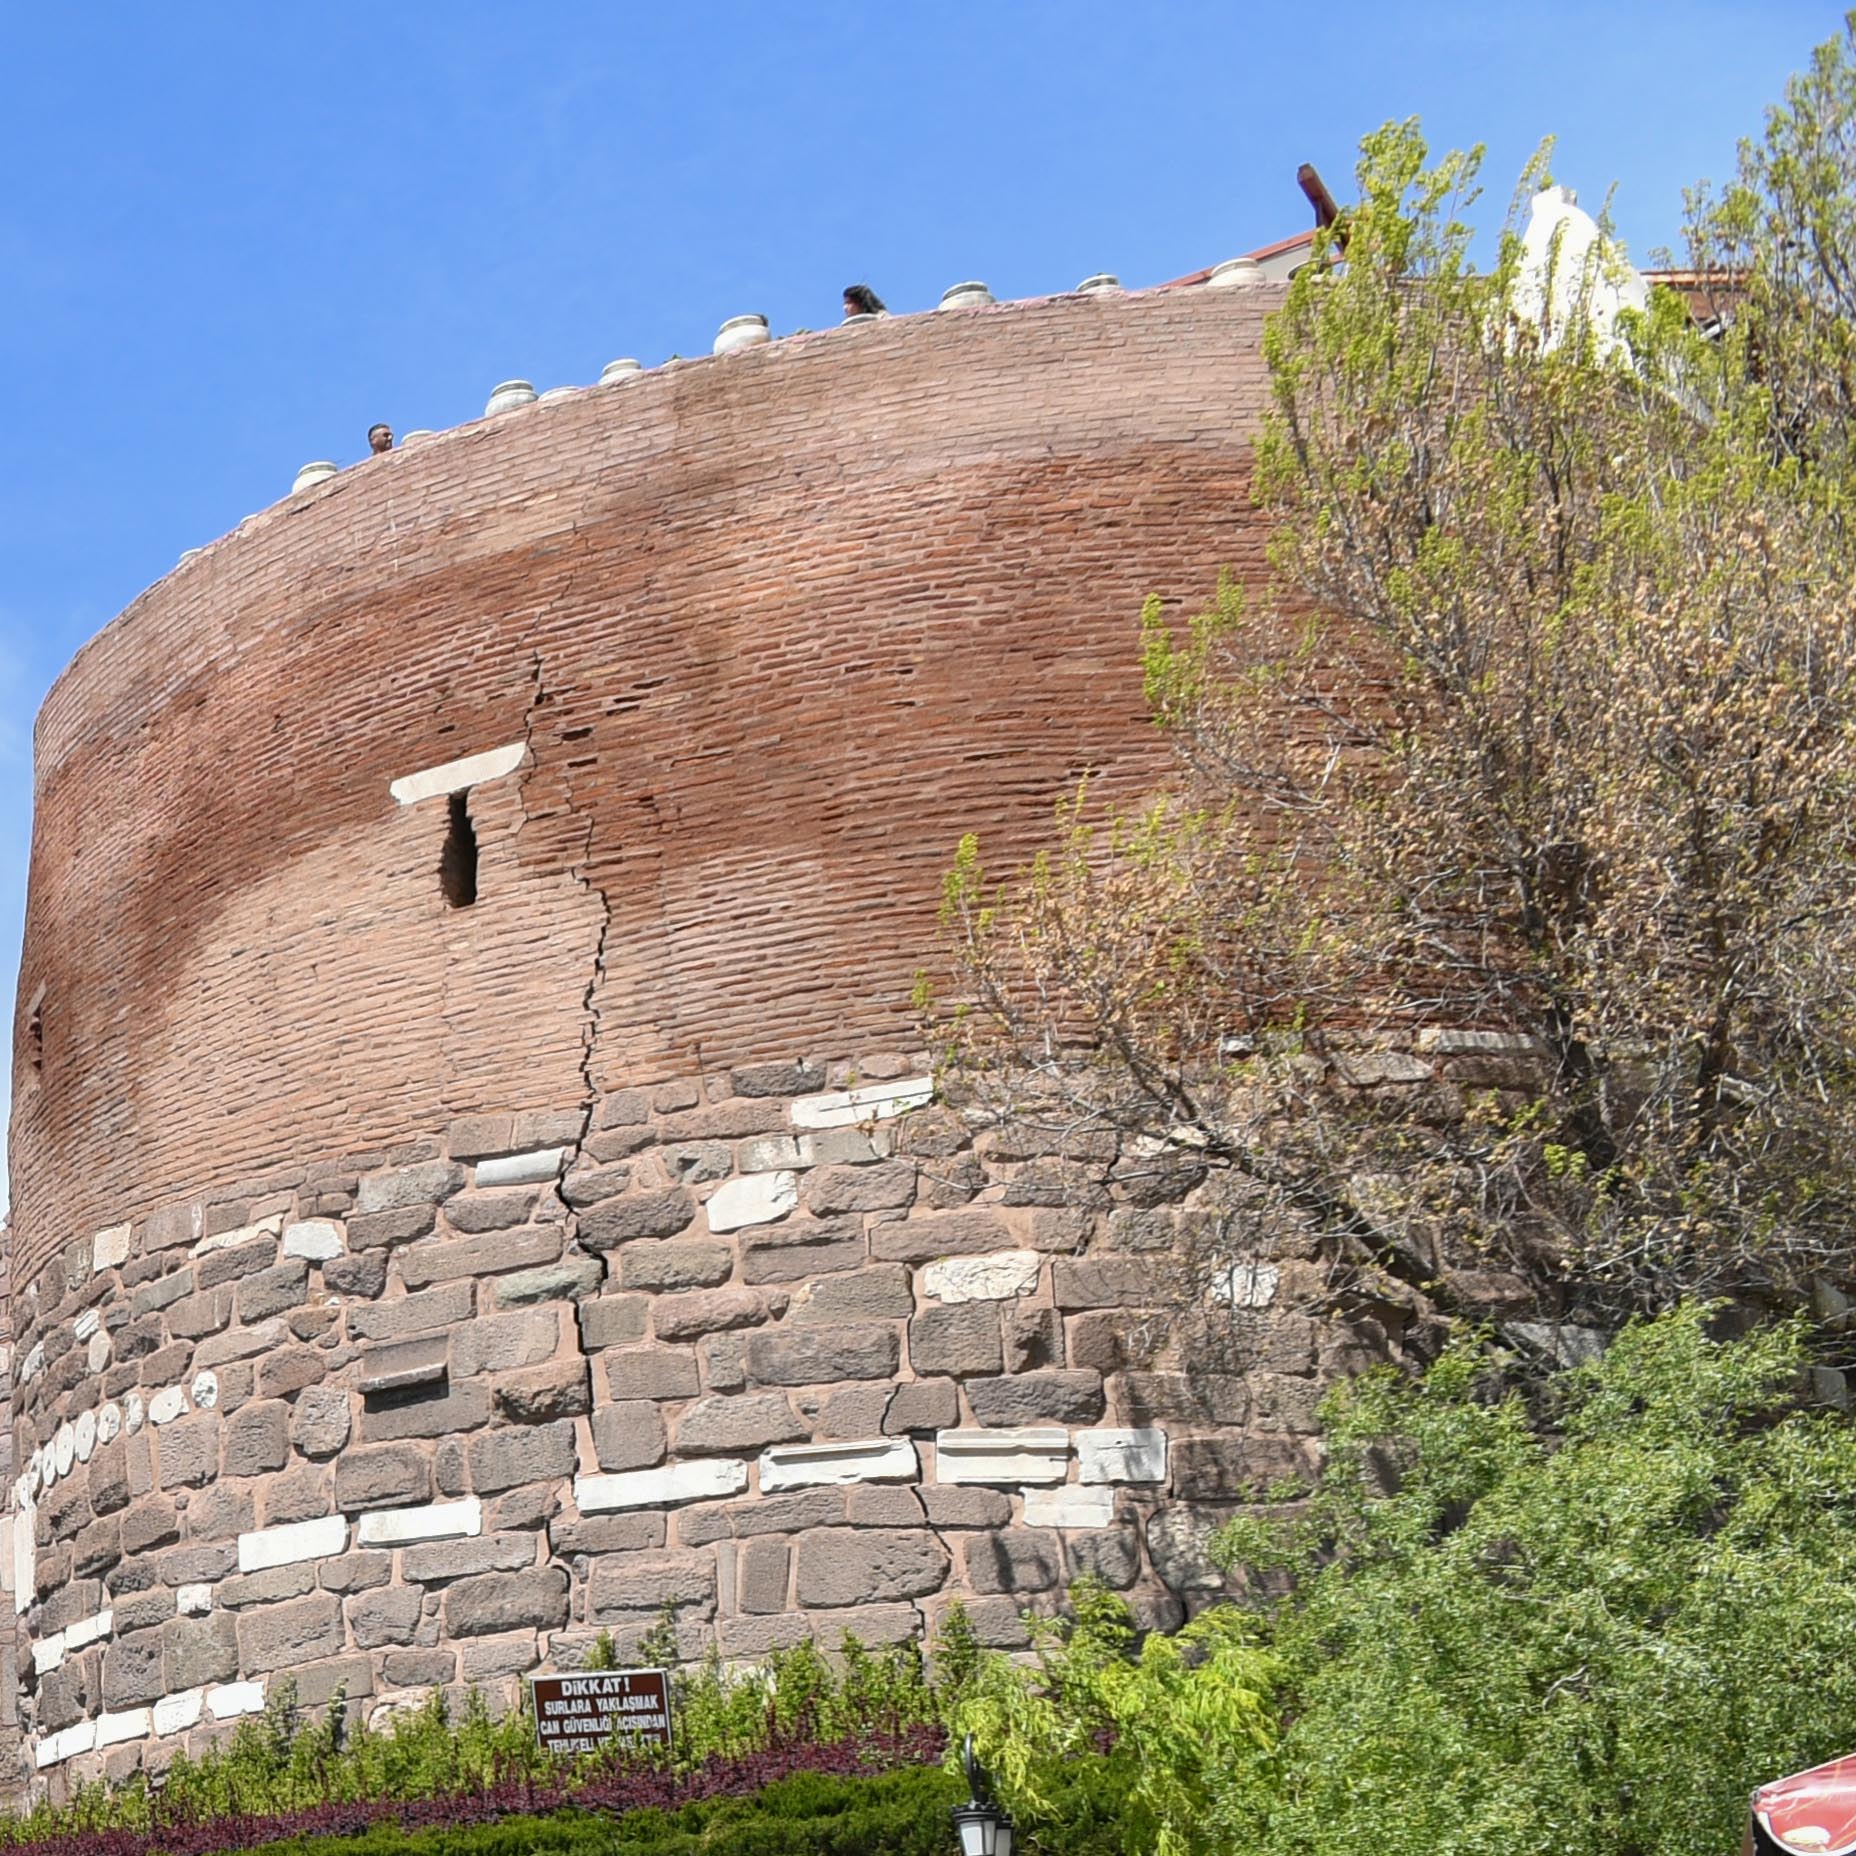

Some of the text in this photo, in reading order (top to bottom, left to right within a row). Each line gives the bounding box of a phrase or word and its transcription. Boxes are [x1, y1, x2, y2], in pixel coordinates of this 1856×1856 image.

[544, 1694, 659, 1716] SURLARA YAKLAŞMAK
[540, 1720, 560, 1735] CAN
